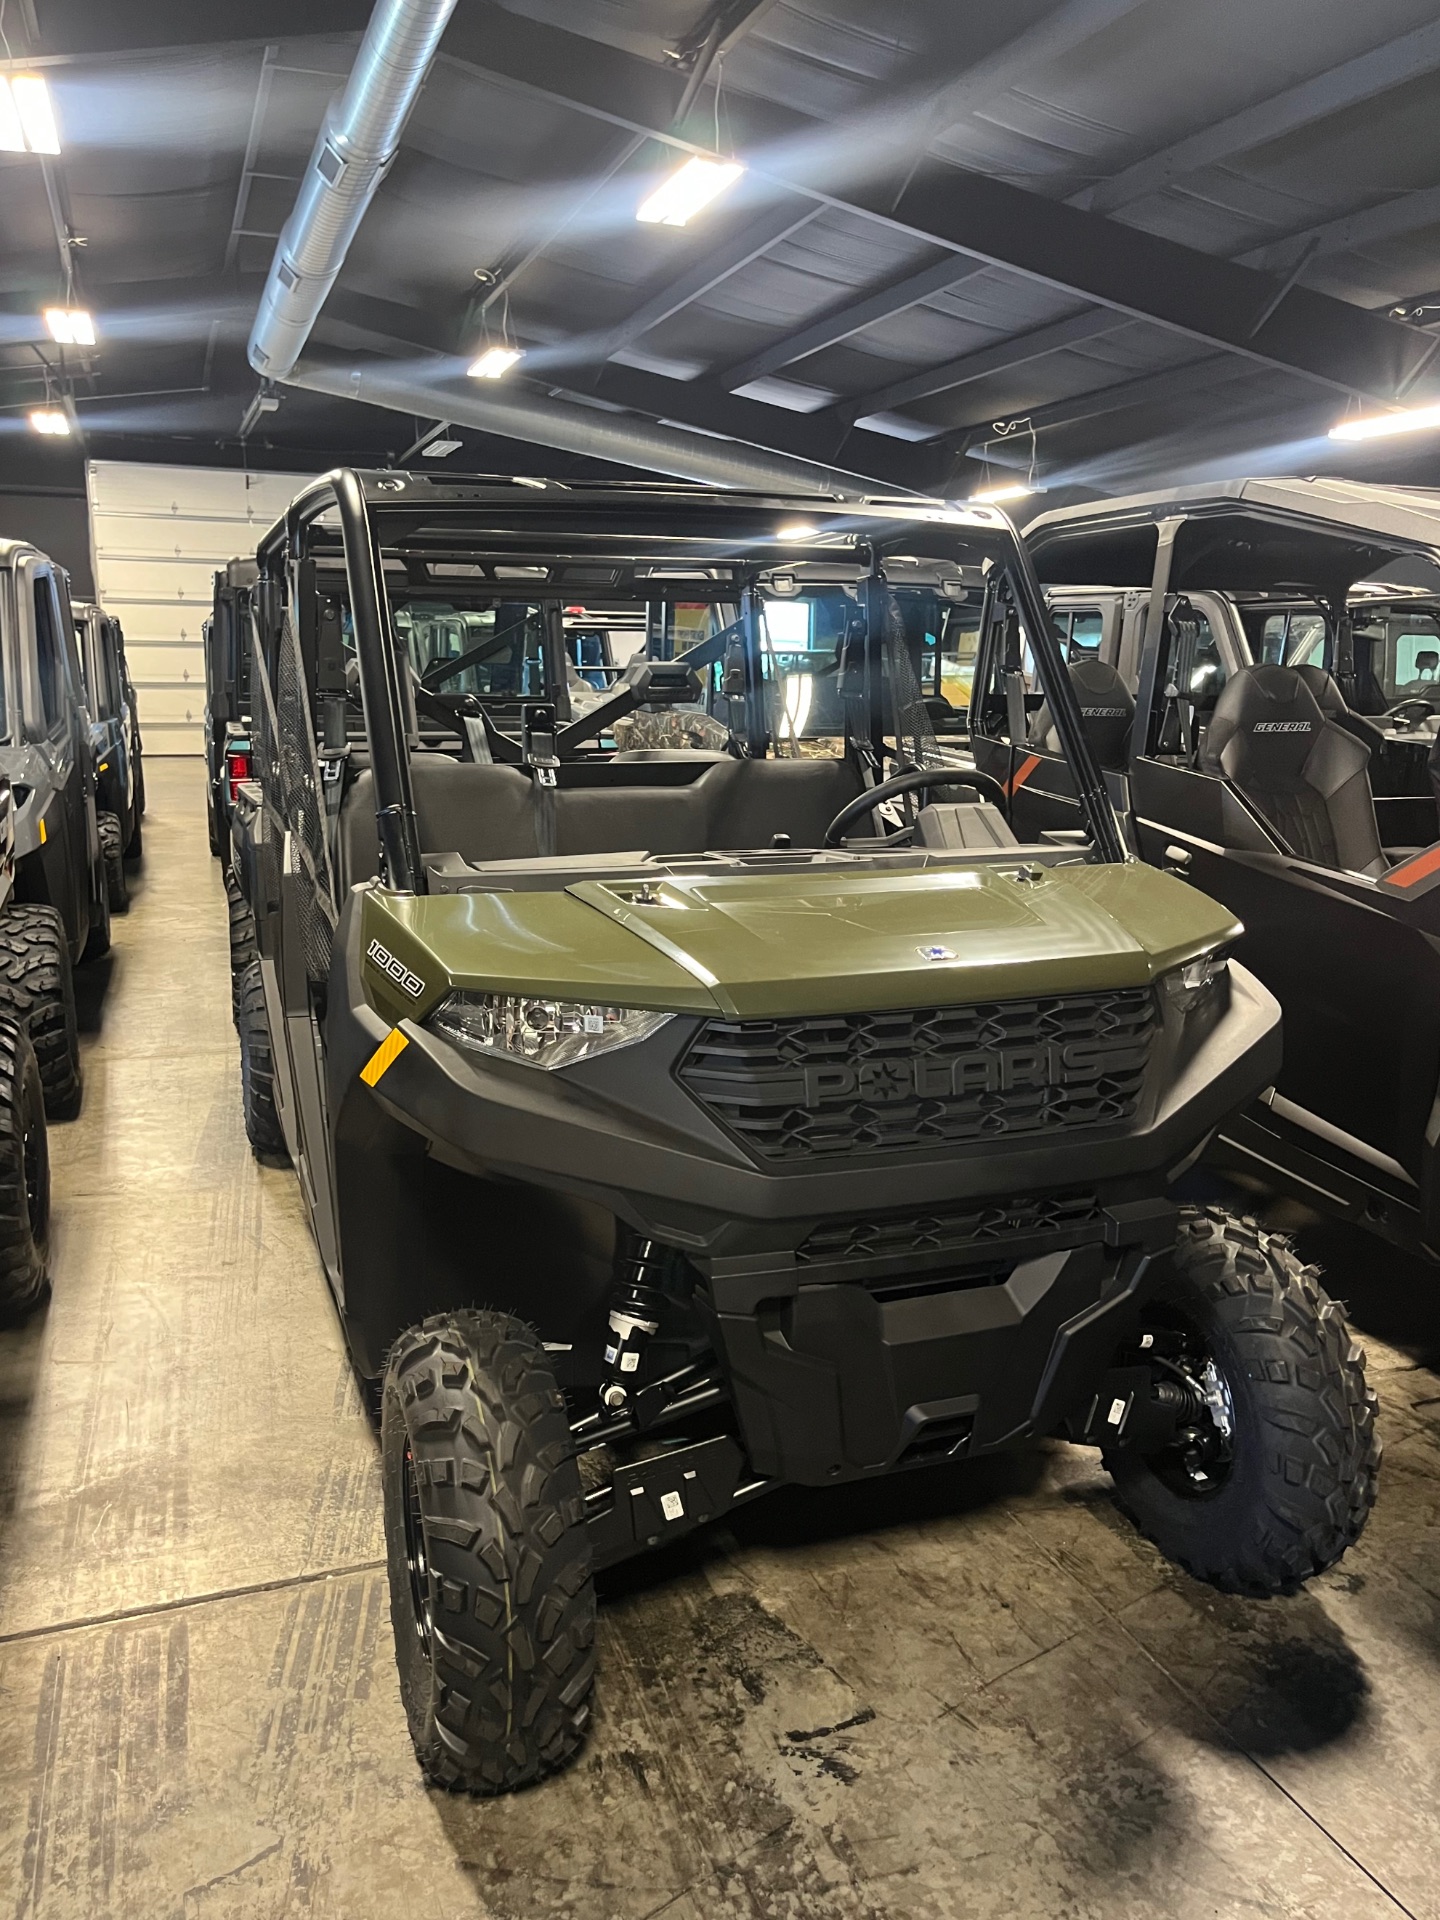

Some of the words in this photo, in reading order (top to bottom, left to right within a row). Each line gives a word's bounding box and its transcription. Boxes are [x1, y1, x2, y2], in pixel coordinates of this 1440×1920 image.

[1253, 722, 1312, 733] GENERAL
[367, 938, 426, 998] 1000
[803, 1043, 1104, 1108] POLARIS
